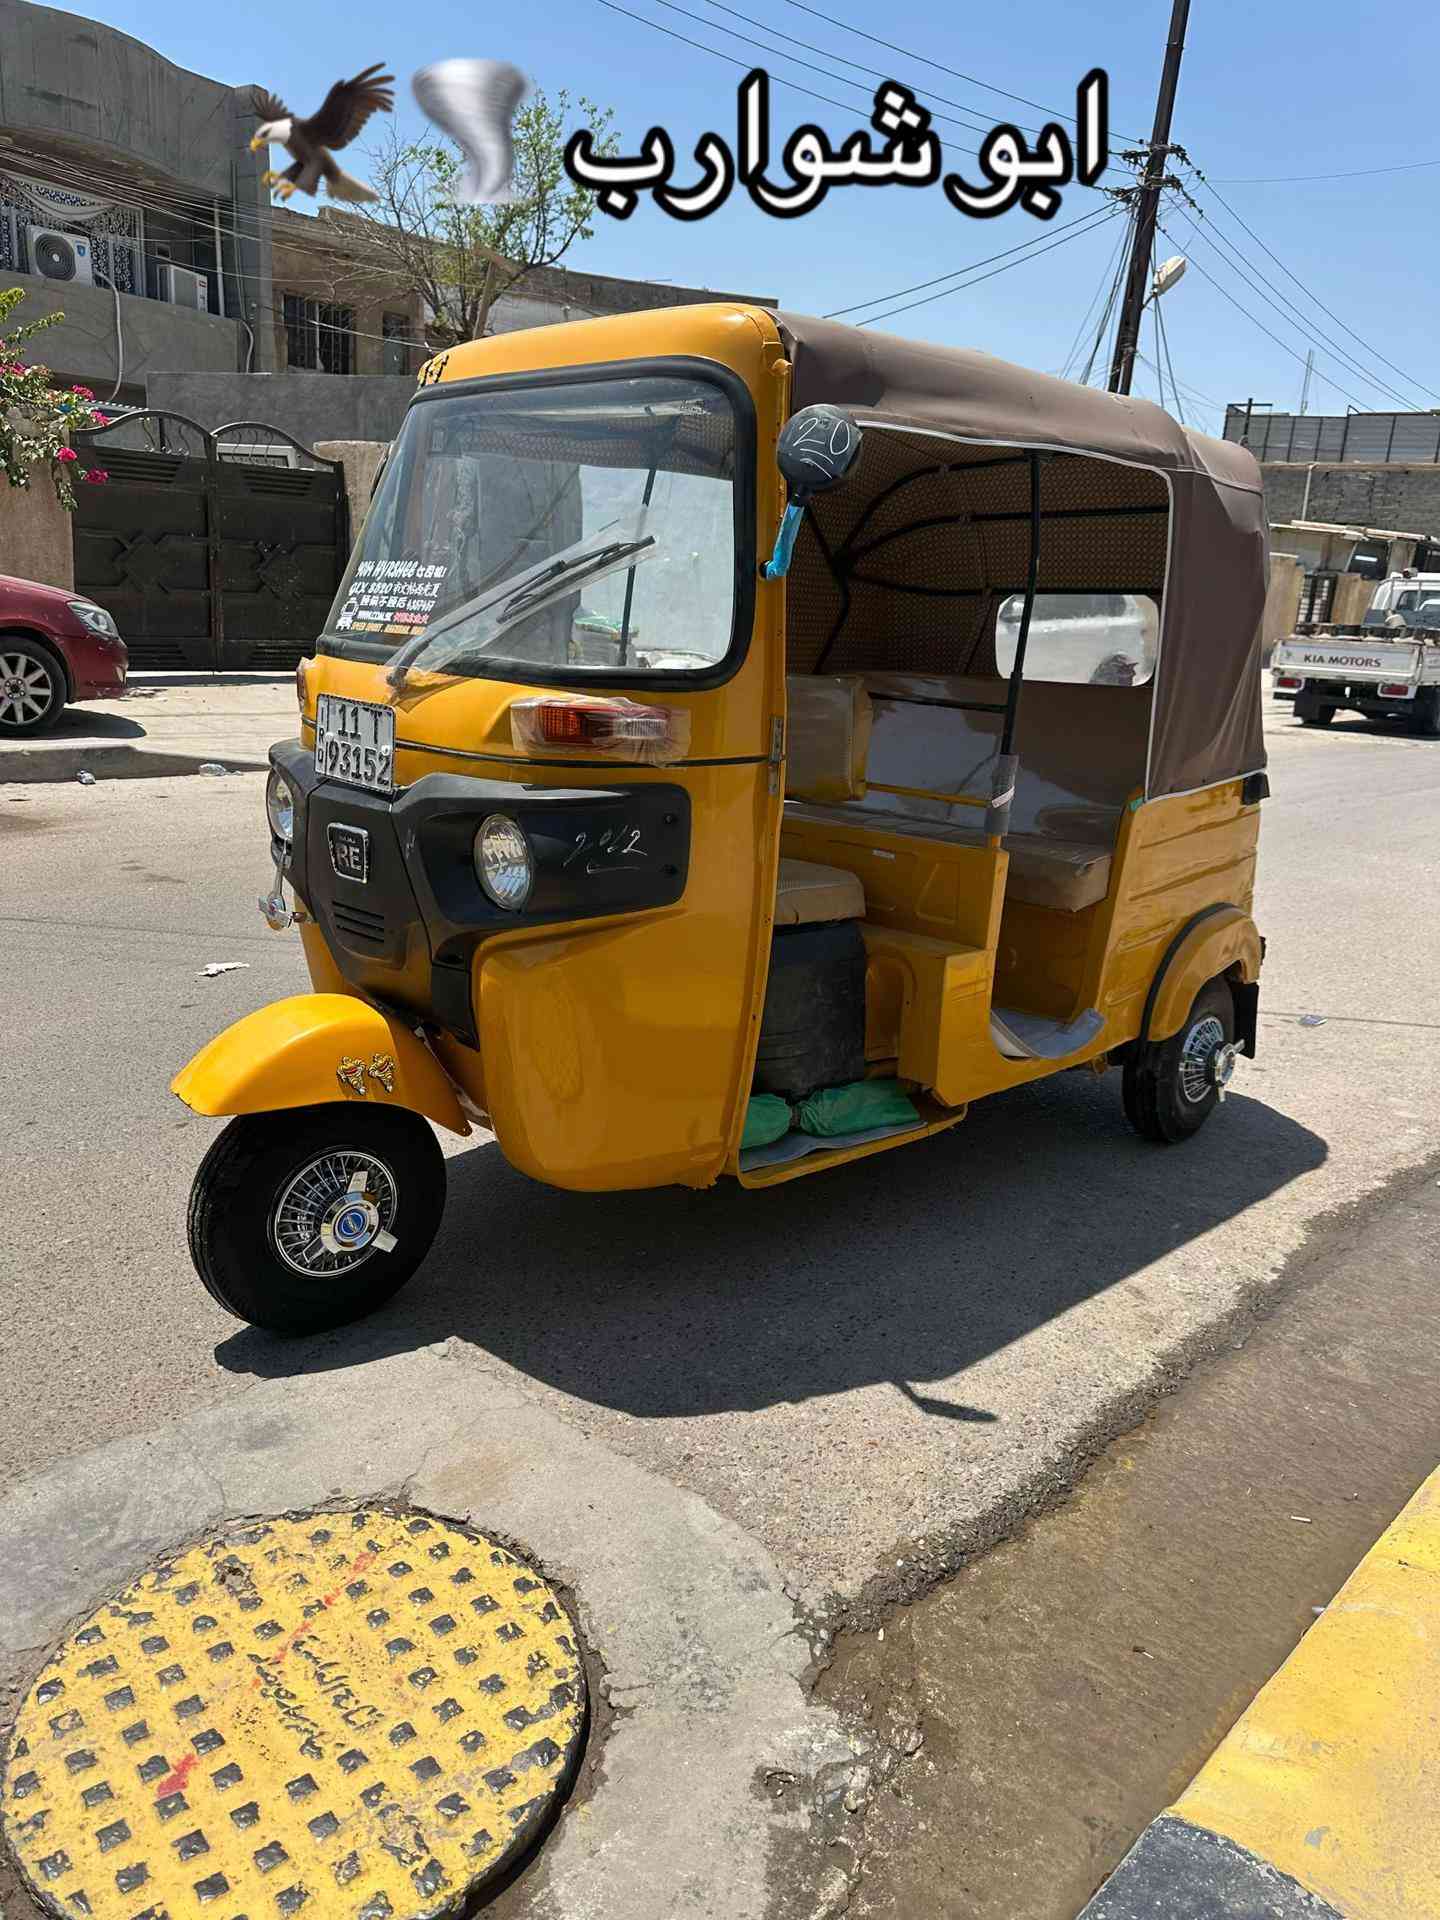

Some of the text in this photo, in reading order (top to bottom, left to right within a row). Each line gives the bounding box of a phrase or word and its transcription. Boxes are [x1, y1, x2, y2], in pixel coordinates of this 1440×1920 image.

[793, 418, 851, 456] 20
[1303, 654, 1382, 668] KIA MOTORS
[328, 740, 390, 786] 93152
[335, 842, 362, 871] RE
